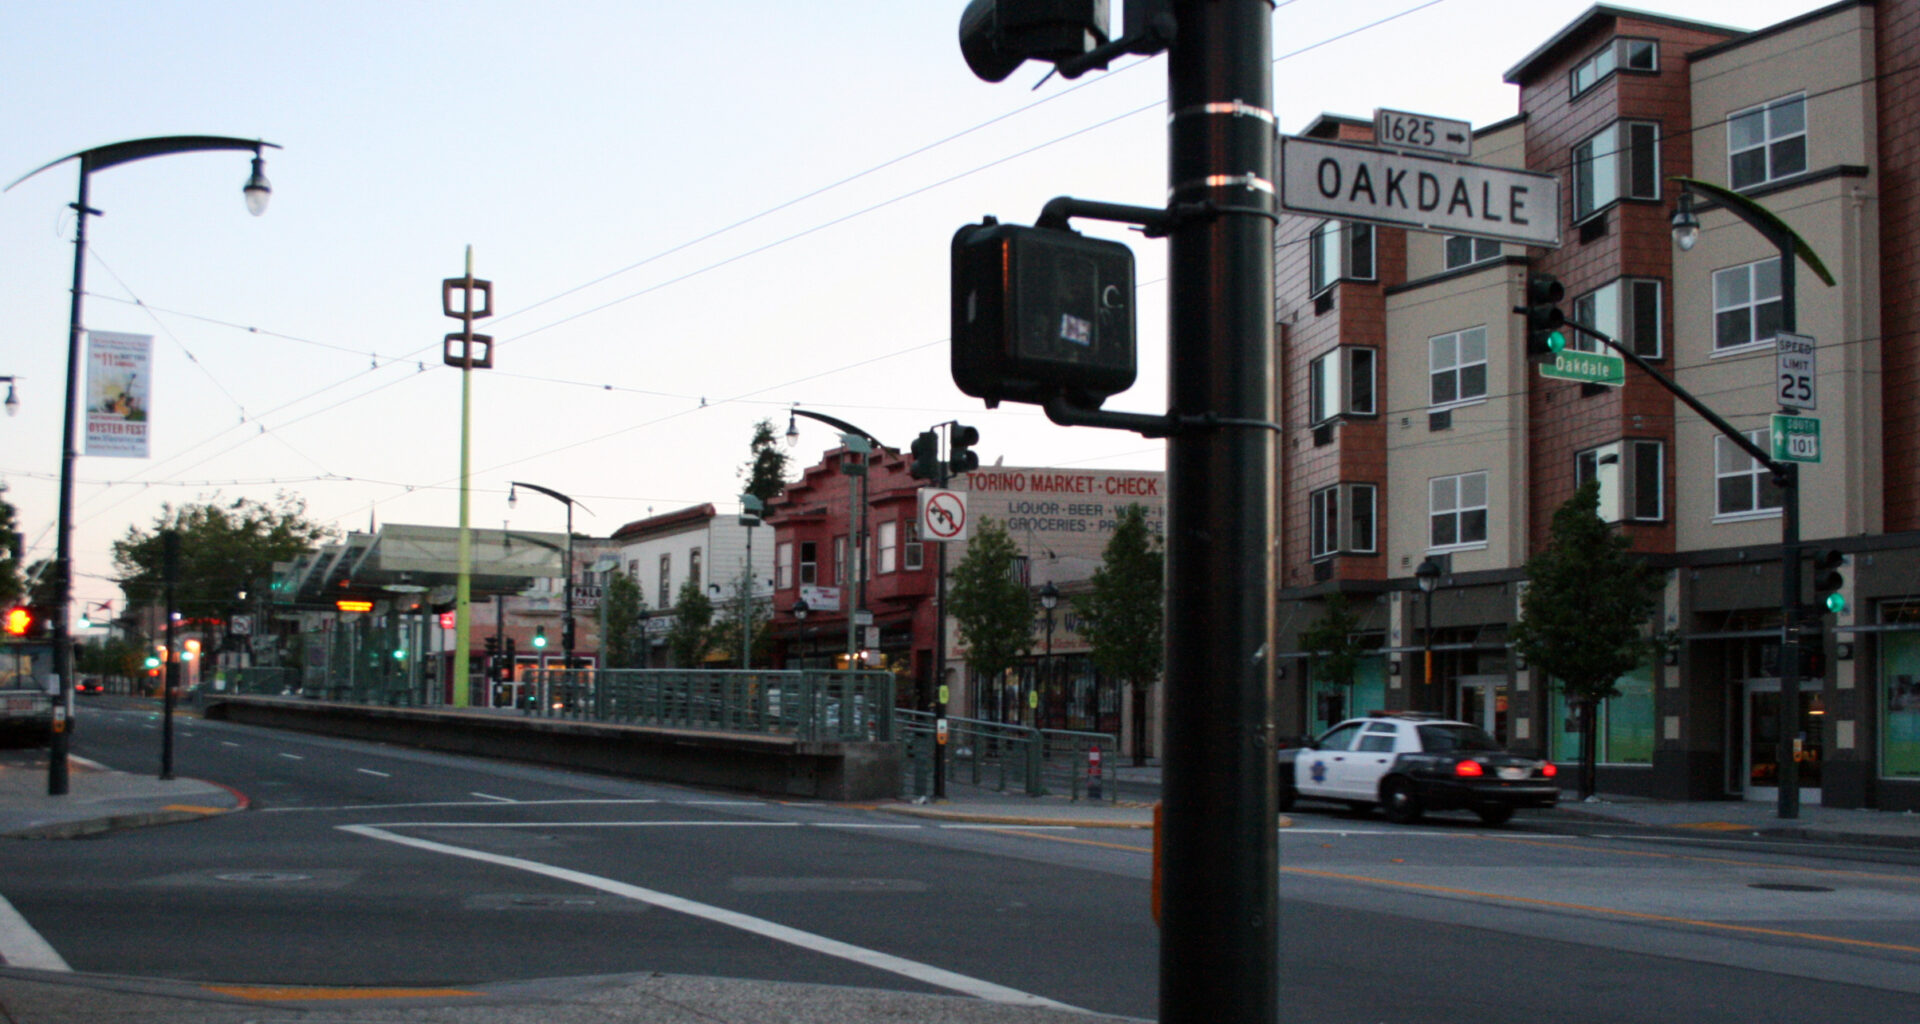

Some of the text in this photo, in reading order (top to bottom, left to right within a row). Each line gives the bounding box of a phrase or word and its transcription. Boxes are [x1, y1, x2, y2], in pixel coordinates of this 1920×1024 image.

[1382, 114, 1435, 146] 1625
[1317, 157, 1530, 225] OAKDALE
[1780, 341, 1812, 354] SPEED
[1555, 355, 1609, 377] Oakdale
[1783, 359, 1809, 370] LIMIT
[1781, 374, 1811, 401] 25
[89, 422, 148, 436] OYSTER FEST
[1792, 438, 1812, 454] 101
[966, 472, 1158, 496] TORINO MARKET CHECK
[1008, 501, 1060, 516] LIQUOR
[1068, 503, 1103, 517] BEER
[1113, 505, 1150, 519] WE
[1008, 517, 1087, 533] GROCERIES
